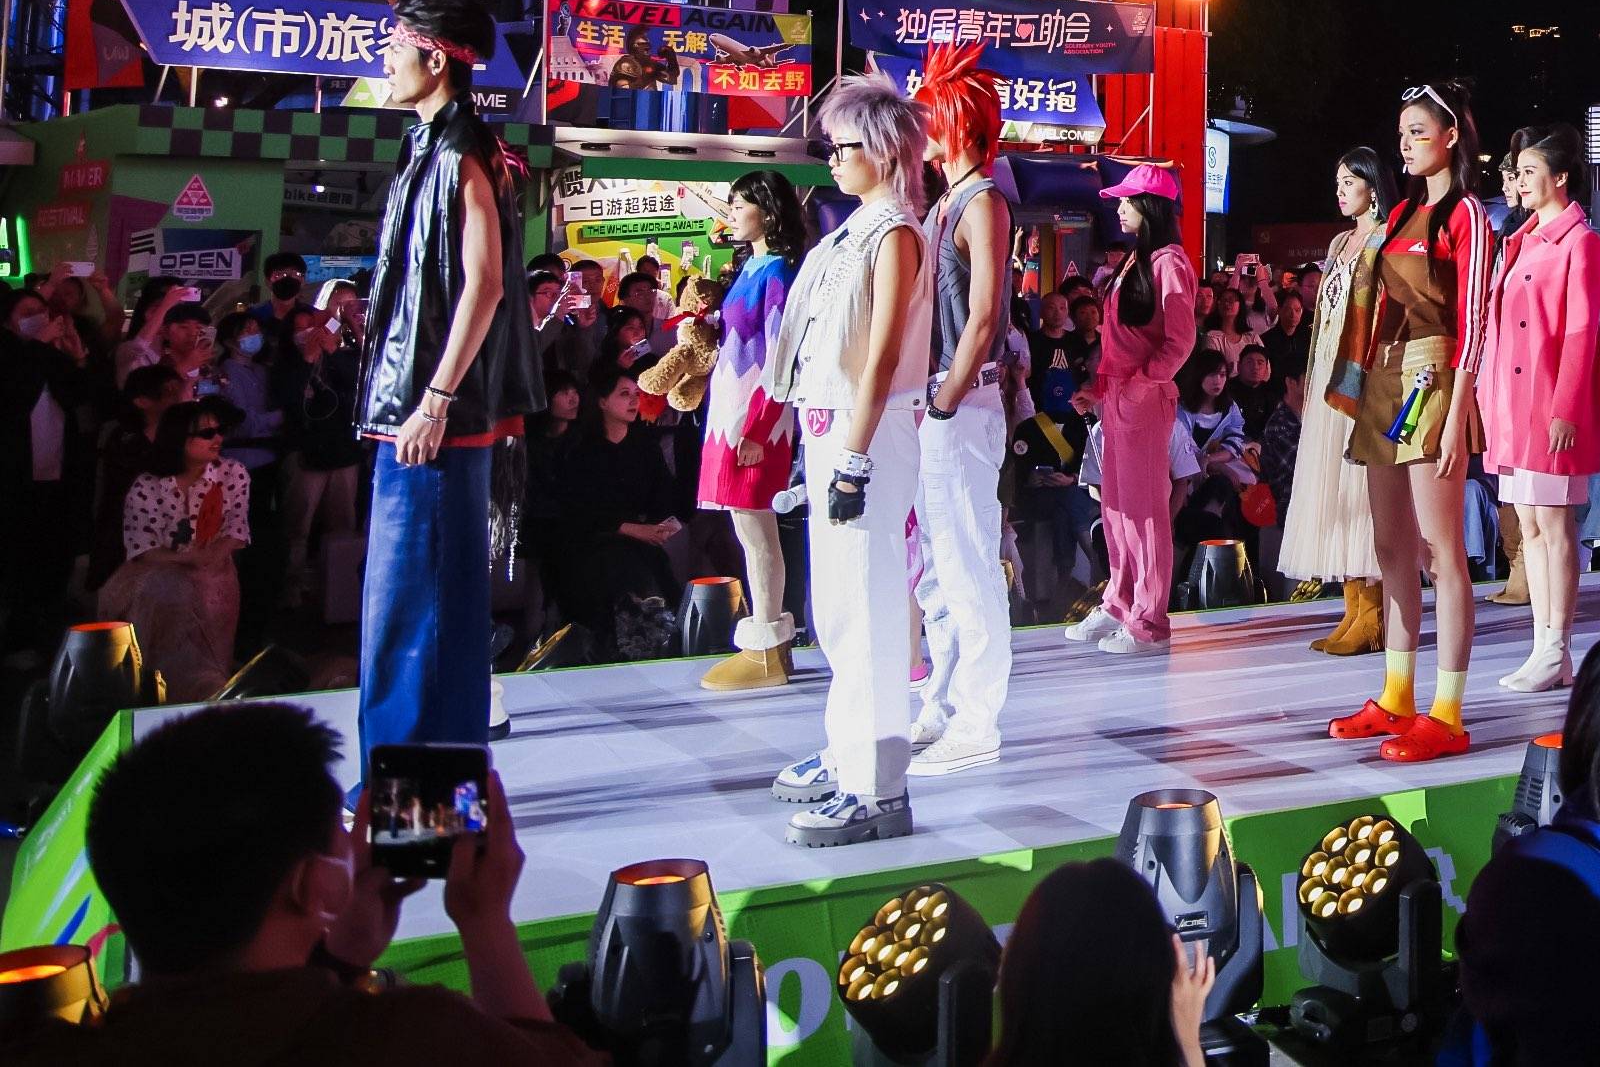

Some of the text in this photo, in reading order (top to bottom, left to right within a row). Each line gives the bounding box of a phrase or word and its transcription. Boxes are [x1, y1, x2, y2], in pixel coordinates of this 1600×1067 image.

[683, 10, 775, 34] AGAIN
[895, 7, 1092, 54] 独居青年互助会
[575, 20, 709, 55] 生活 无解
[713, 68, 805, 92] 不如去野
[1033, 127, 1096, 143] WELCOME
[569, 194, 675, 218] 一日游超短途
[588, 219, 705, 236] THE WHOLE WORLD AWAITS
[159, 250, 234, 270] OPEN
